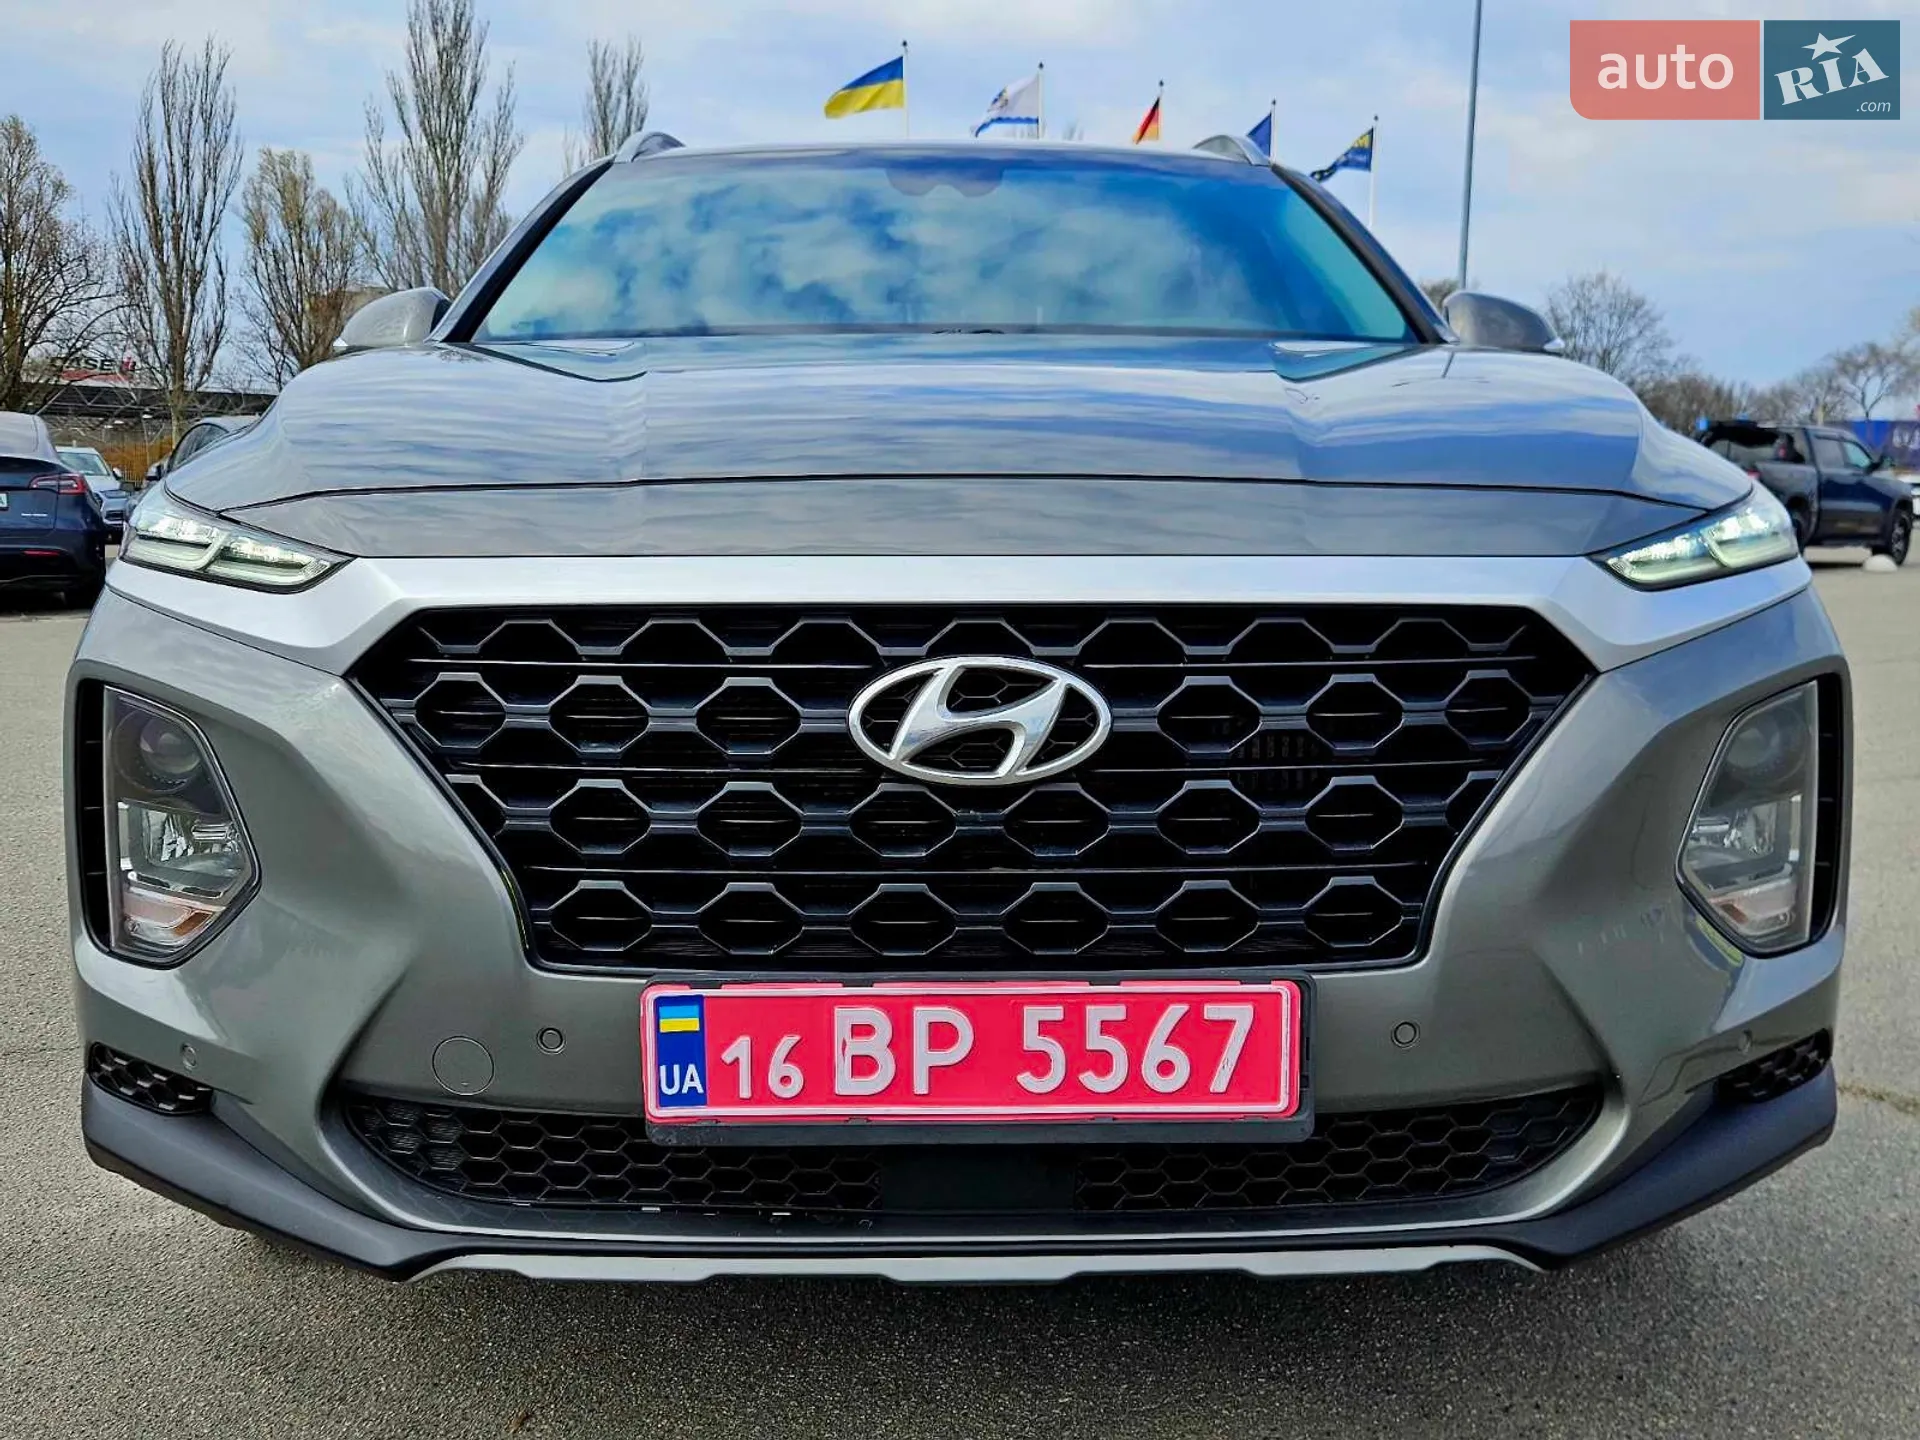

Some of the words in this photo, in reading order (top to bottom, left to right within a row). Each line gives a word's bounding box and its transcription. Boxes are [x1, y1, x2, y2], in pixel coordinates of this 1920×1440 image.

[659, 1063, 704, 1096] UA
[721, 1035, 805, 1100] 16
[834, 1006, 976, 1096] BP
[1016, 1004, 1255, 1095] 5567
